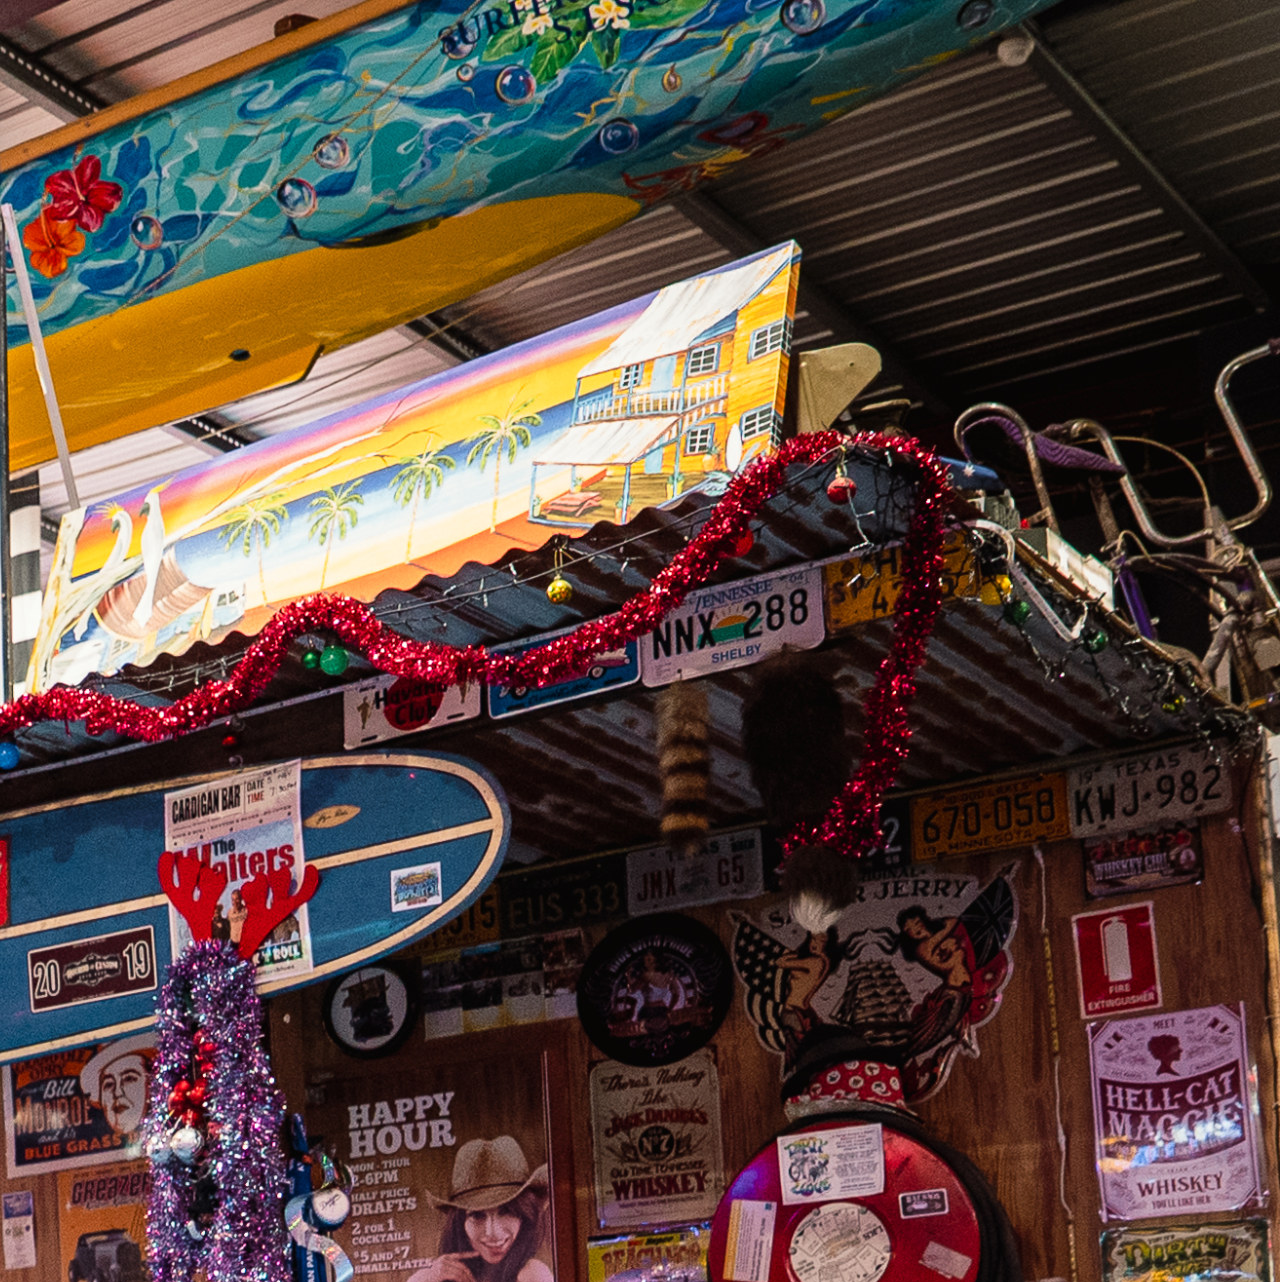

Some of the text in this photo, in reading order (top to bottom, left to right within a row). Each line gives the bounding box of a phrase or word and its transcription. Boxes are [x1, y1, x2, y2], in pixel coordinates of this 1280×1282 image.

[693, 580, 773, 613] TENNESSEE
[653, 588, 808, 660] NNX 288
[712, 643, 762, 664] SHELBY
[395, 704, 438, 726] Club
[1114, 753, 1182, 778] TEXAS
[246, 778, 265, 792] DATE
[172, 788, 220, 824] CARDIGAN
[221, 784, 241, 809] BAR
[247, 790, 265, 804] TIME
[212, 837, 236, 856] The
[638, 855, 745, 901] JMX G5
[572, 881, 620, 919] 333
[873, 878, 972, 901] JERRY
[34, 940, 151, 999] 20 19
[1109, 981, 1131, 994] FIRE
[1088, 991, 1155, 1012] EXTINGUISHER
[1153, 1018, 1175, 1030] MEET
[656, 1066, 705, 1087] Nothing
[43, 1078, 77, 1099] Bill
[1106, 1067, 1237, 1111] HELL-CAT
[15, 1094, 93, 1136] MONROE
[347, 1091, 455, 1130] HAPPY
[605, 1112, 643, 1138] JACK
[24, 1130, 123, 1161] BLUE GRASS
[349, 1119, 457, 1158] HOUR
[351, 1187, 410, 1202] HALF PRICE
[612, 1171, 706, 1201] WHISKEY
[1137, 1171, 1223, 1197] WHISKEY
[352, 1197, 417, 1217] DRAFTS
[352, 1222, 361, 1235] 2
[352, 1230, 411, 1245] COCKTAILS
[354, 1258, 433, 1274] SMALL PLATES
[371, 1252, 394, 1261] AND
